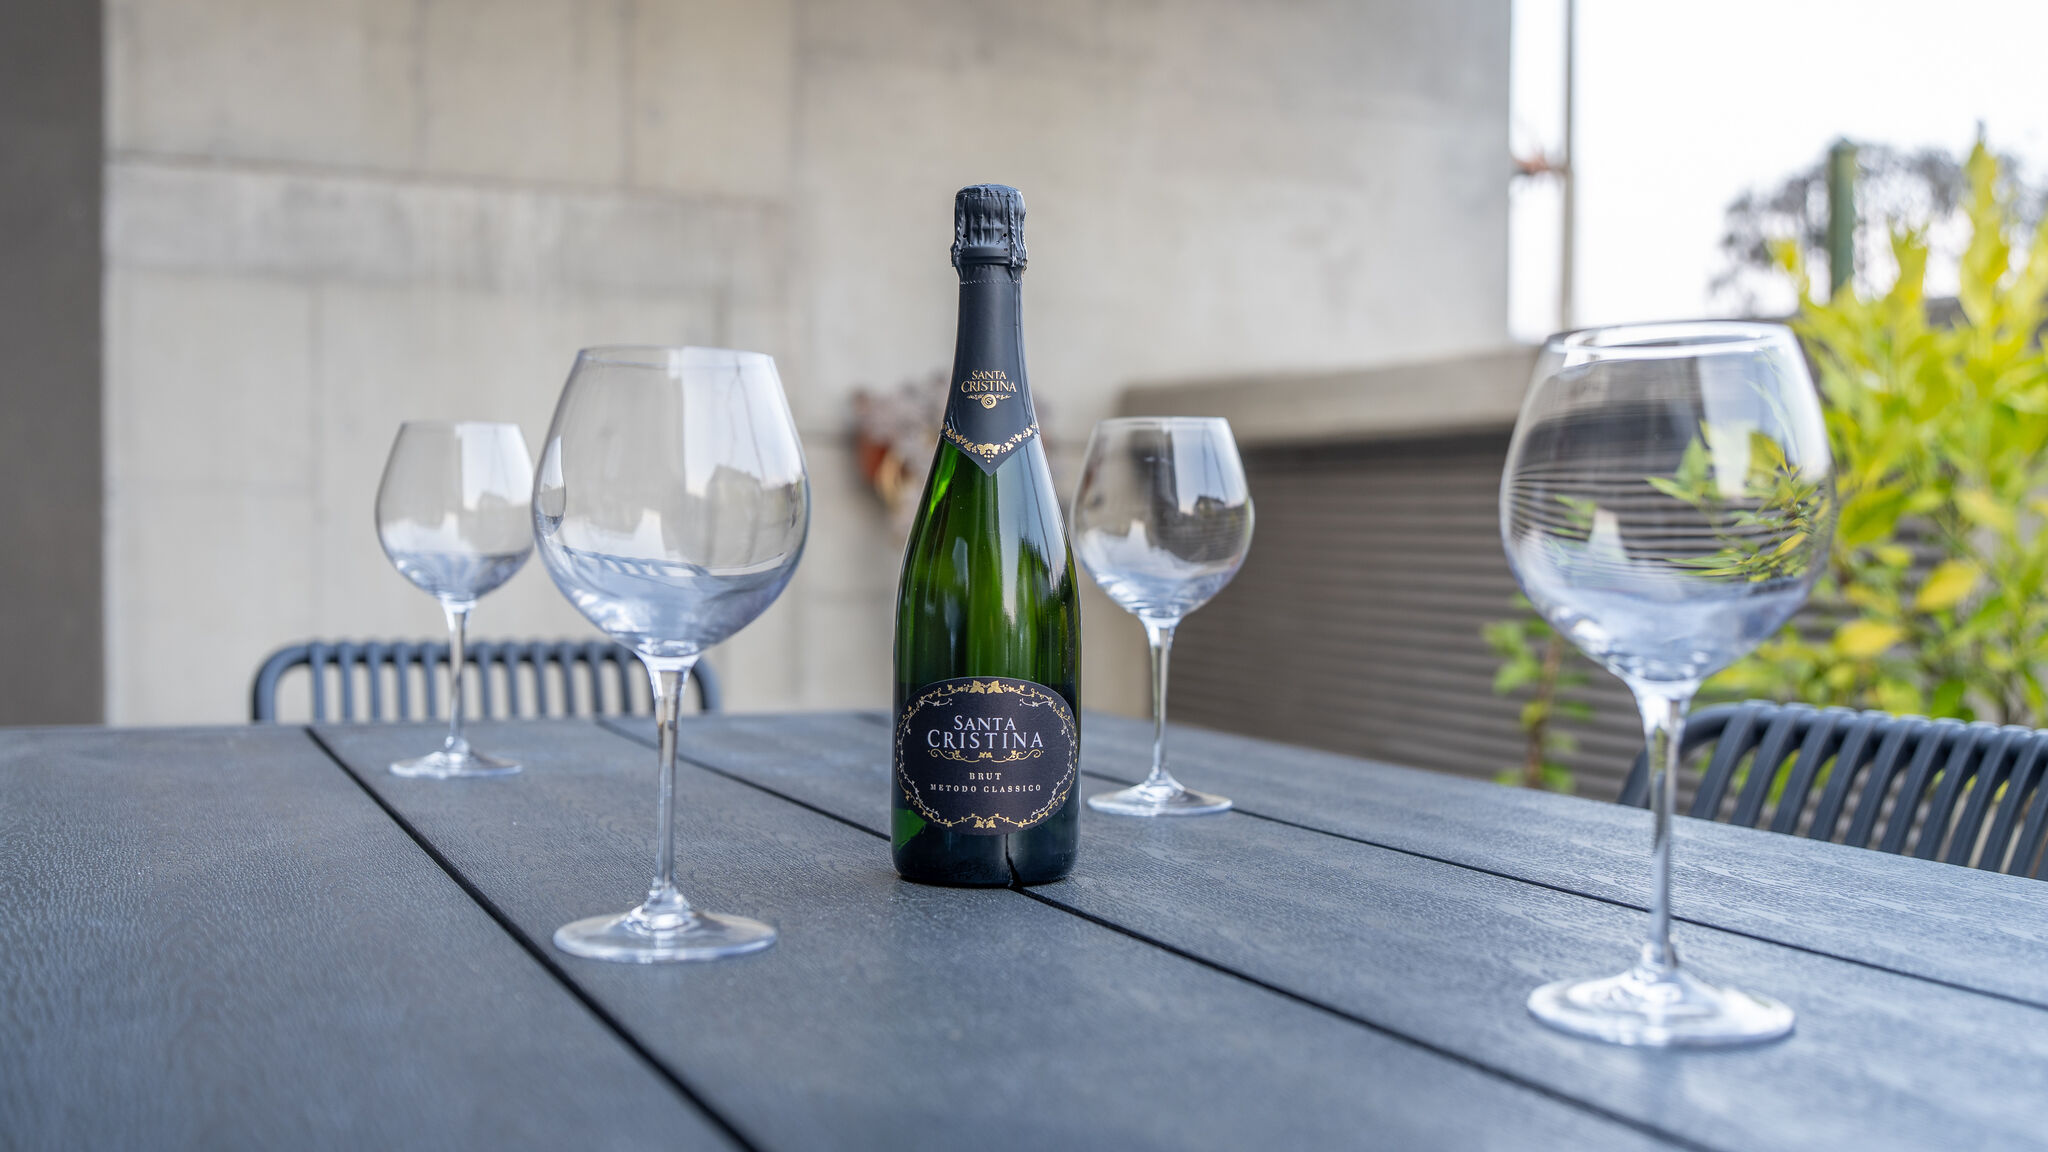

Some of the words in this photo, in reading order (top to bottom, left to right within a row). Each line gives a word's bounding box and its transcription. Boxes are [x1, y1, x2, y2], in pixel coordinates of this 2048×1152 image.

[971, 370, 1007, 380] SANTA
[961, 380, 1017, 393] CRISTINA
[953, 715, 1017, 731] SANTA
[927, 729, 1044, 749] CRISTINA
[969, 772, 1002, 780] BRUT
[930, 783, 977, 793] METODO
[983, 784, 1041, 793] CLASSICO
